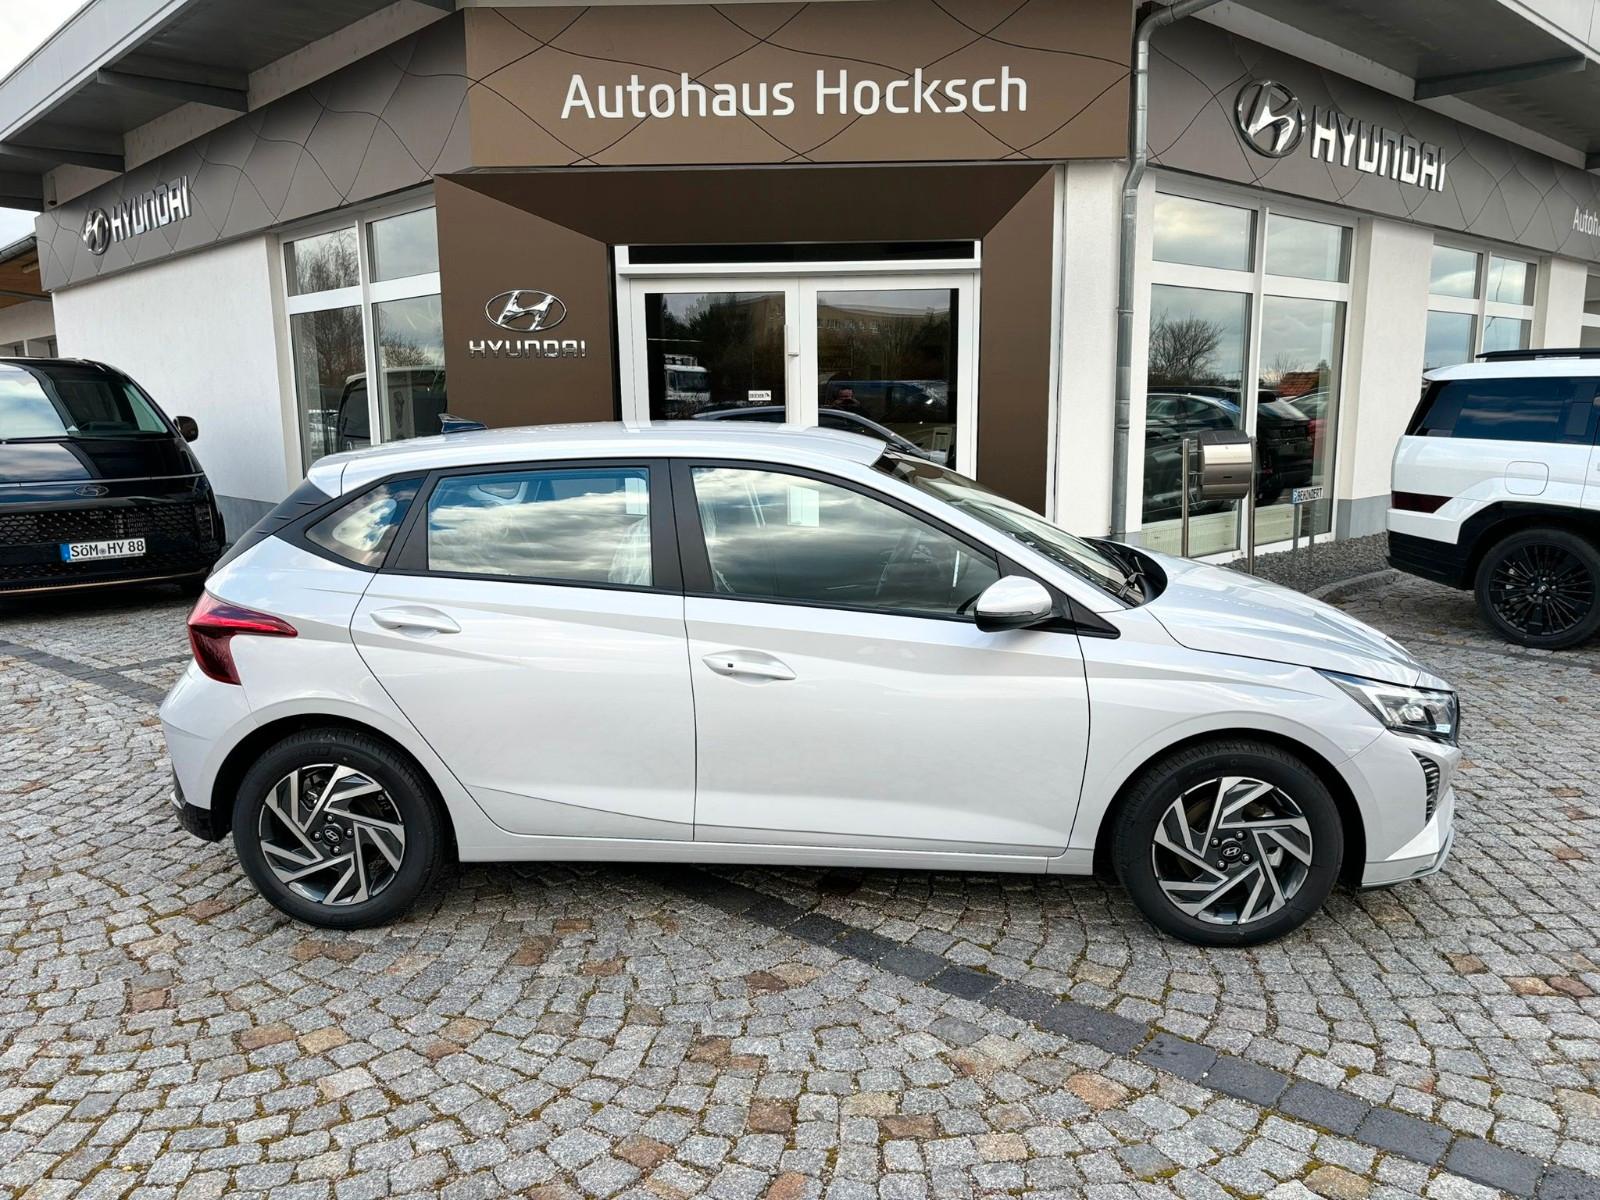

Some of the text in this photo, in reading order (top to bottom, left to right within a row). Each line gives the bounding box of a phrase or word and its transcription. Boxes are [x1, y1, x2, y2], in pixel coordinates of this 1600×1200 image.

[561, 66, 1027, 119] Autohaus Hocksch
[1311, 105, 1446, 192] HYUNDAI
[111, 175, 192, 242] HYUNDAI
[1572, 206, 1600, 237] Autoh
[468, 340, 586, 358] HYUNDAI
[107, 542, 124, 554] HY
[127, 540, 144, 552] 88
